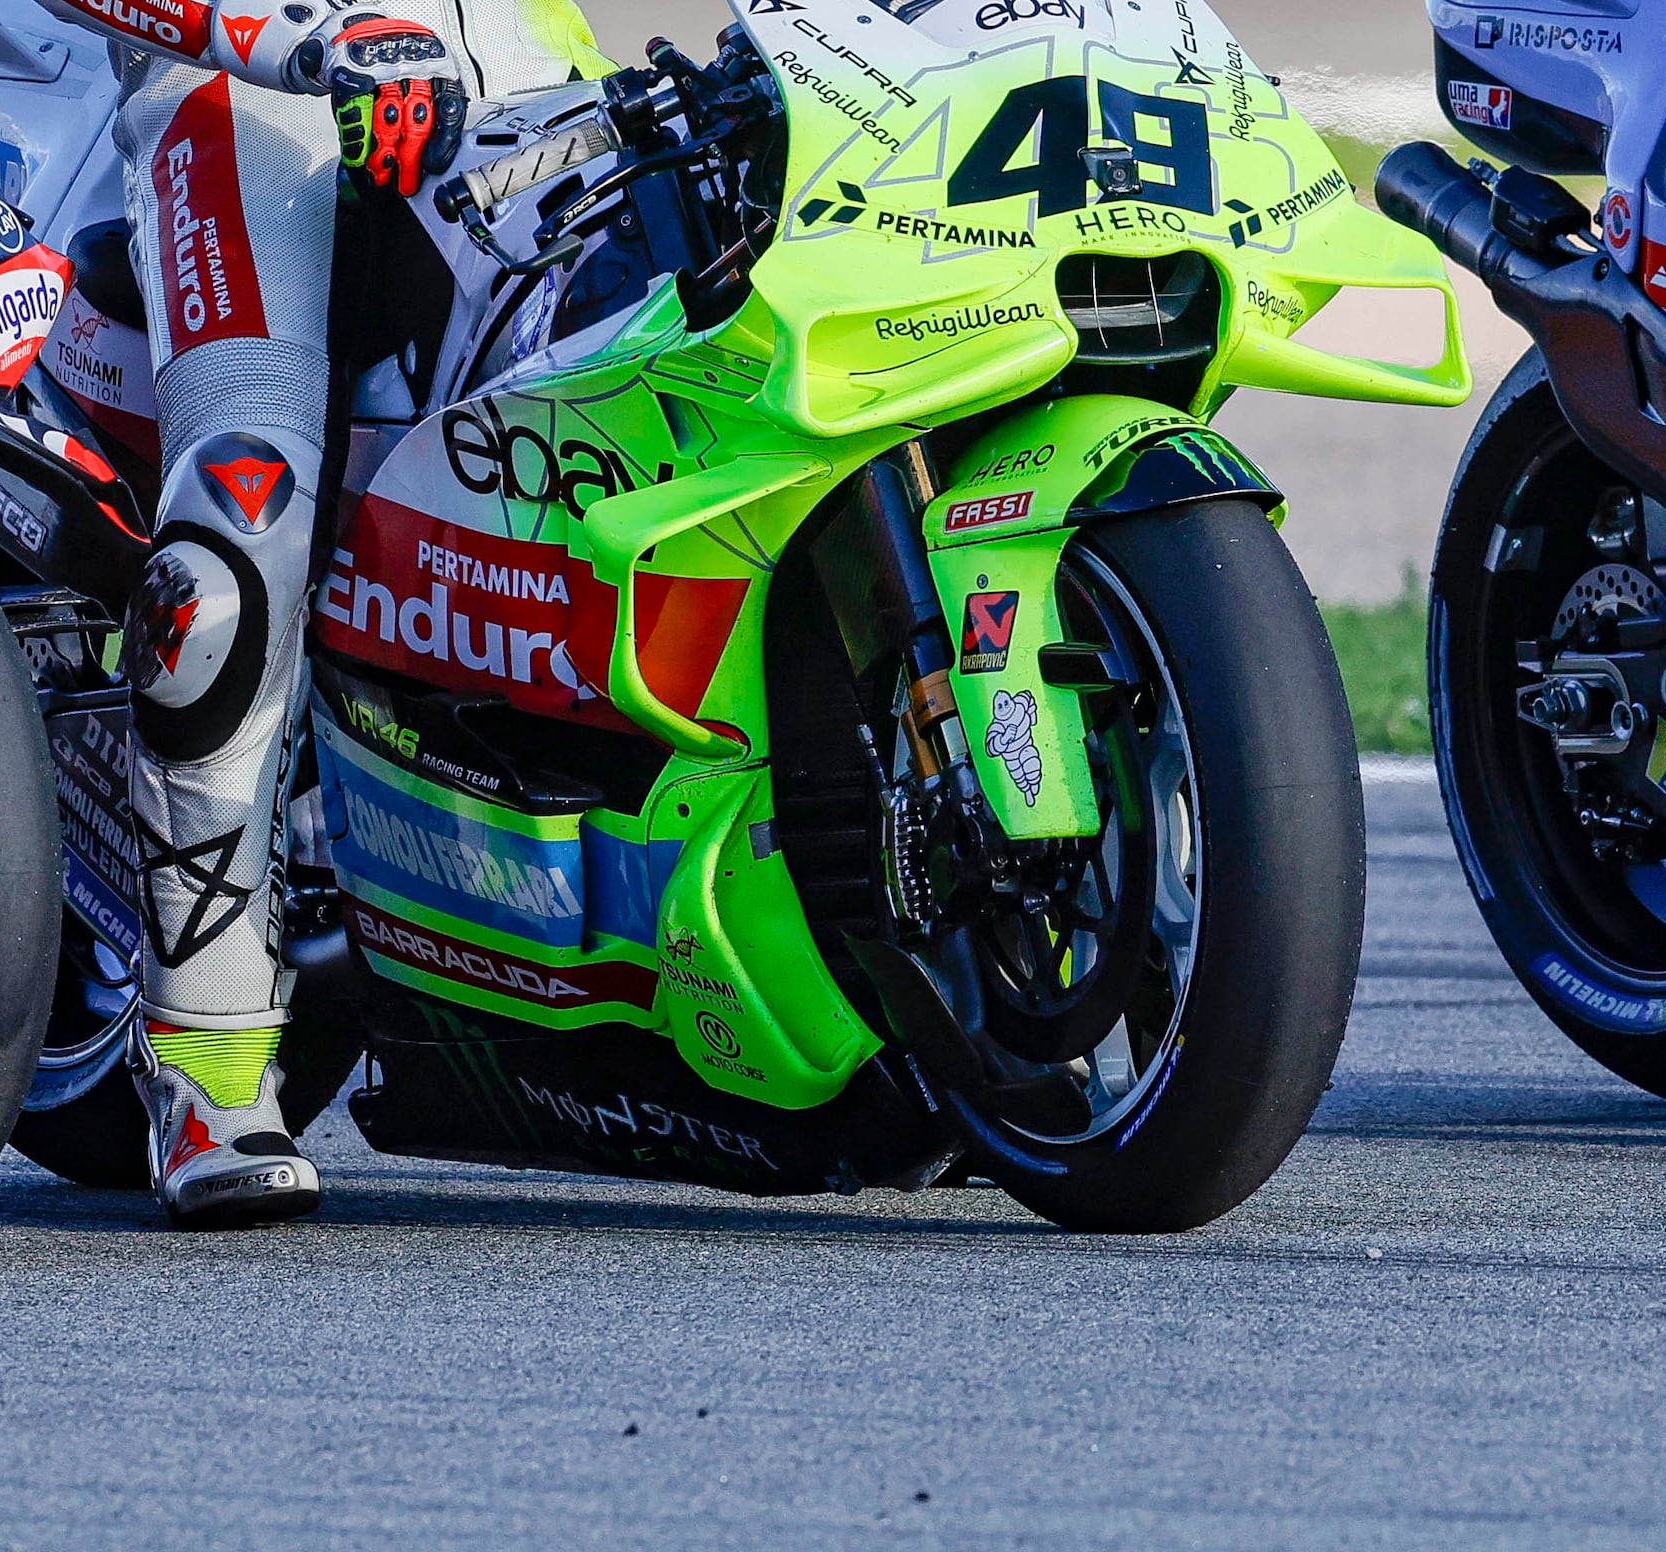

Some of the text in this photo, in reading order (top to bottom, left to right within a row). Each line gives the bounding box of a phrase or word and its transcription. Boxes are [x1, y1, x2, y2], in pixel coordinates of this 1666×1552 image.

[1507, 21, 1624, 55] RISPOSTA
[791, 17, 918, 109] CUPRA
[773, 49, 903, 156] RefrigiWear
[1225, 41, 1257, 143] RefrigiWear
[1448, 81, 1480, 103] uma
[1451, 100, 1490, 127] racing
[946, 73, 1214, 219] 49
[1267, 168, 1347, 227] PERTAMINA
[165, 142, 207, 334] Enduro
[875, 209, 1037, 250] PERTAMINA
[1074, 206, 1188, 238] HERO
[203, 216, 232, 322] PERTAMINA
[873, 298, 1046, 341] RefrigiWear
[0, 342, 35, 373] alimenti
[57, 338, 124, 388] TSUNAMI
[54, 363, 123, 406] NUTRITION
[968, 443, 1057, 484] HERO
[950, 495, 1026, 527] FASSI
[416, 539, 570, 605] PERTAMINA
[421, 751, 501, 791] RACING TEAM
[344, 788, 584, 920] COMOLI FERRARI
[354, 909, 590, 1001] BARRACUDA
[659, 956, 739, 1001] TSUNAMI
[1544, 958, 1645, 1025] MICHELIN
[700, 1051, 734, 1073] MOTO
[517, 1076, 781, 1172] MONSTER
